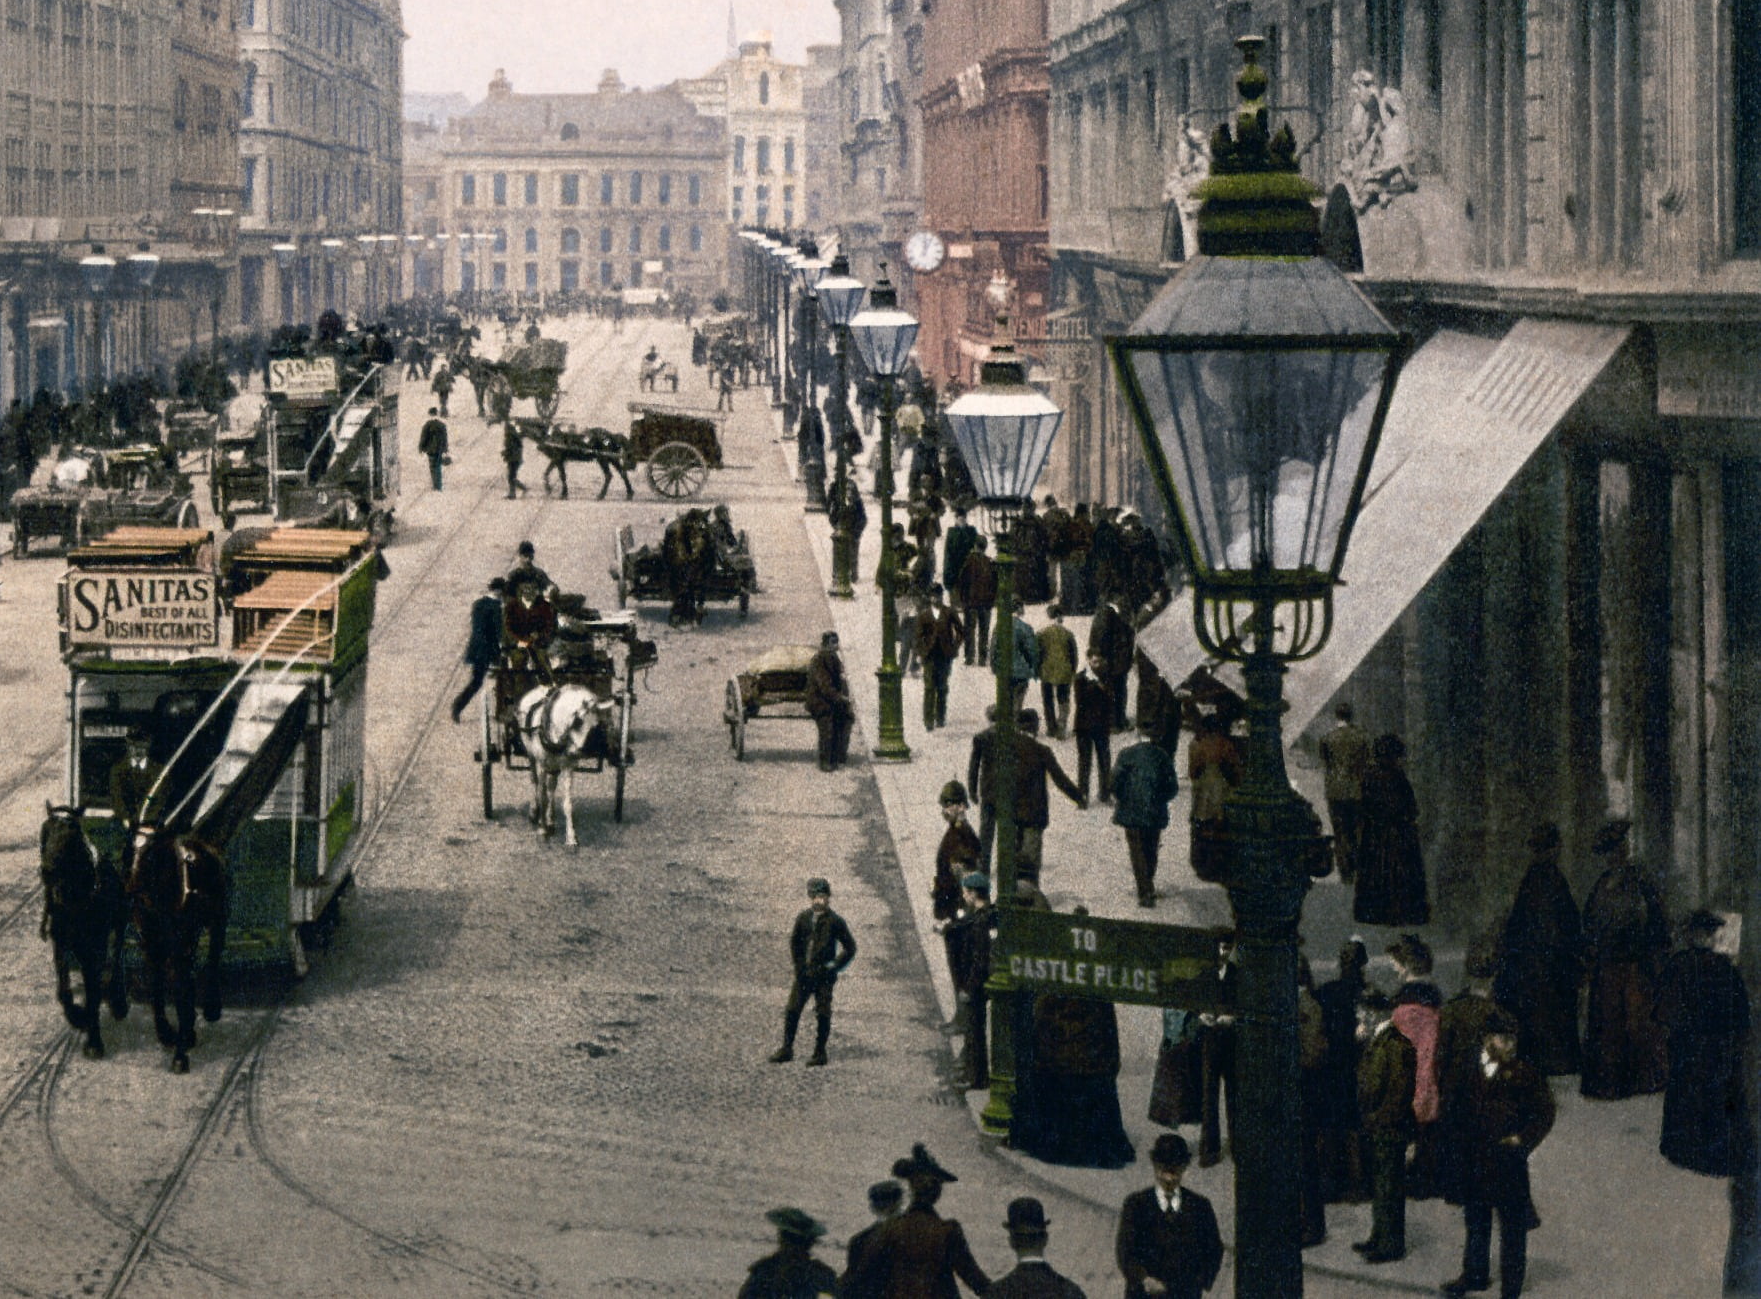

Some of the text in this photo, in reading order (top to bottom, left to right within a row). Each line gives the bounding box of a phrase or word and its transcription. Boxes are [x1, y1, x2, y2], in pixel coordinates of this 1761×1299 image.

[140, 607, 209, 619] BEST OF ALL
[105, 619, 212, 640] DISINFECTANTS
[1070, 927, 1097, 953] TO
[1010, 955, 1159, 994] CASTLE PLACE
